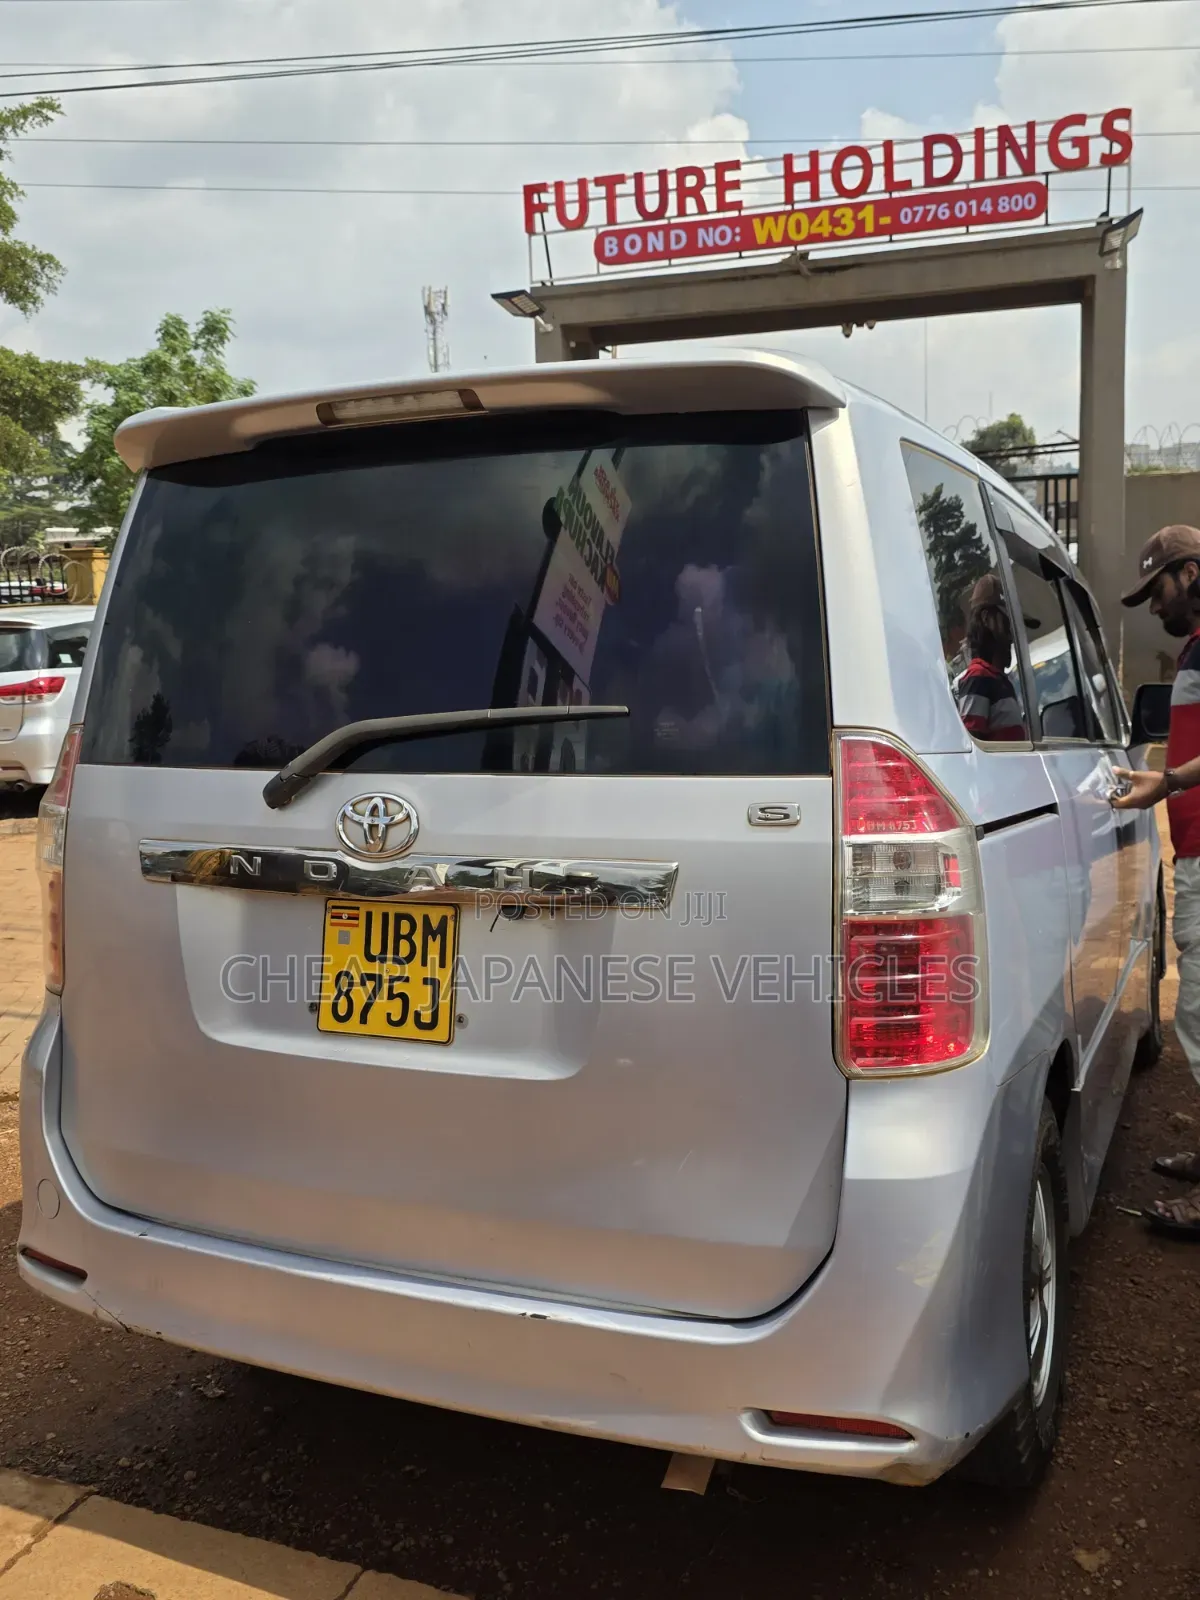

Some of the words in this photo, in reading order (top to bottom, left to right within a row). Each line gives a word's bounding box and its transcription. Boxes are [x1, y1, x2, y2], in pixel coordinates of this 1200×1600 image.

[524, 159, 742, 235] FUTURE
[783, 108, 1134, 204] HOLDINGS
[603, 228, 688, 259] BOND
[697, 223, 742, 250] NO:
[752, 204, 892, 246] W0431-
[900, 201, 951, 225] 0776
[954, 196, 994, 219] 014
[997, 191, 1037, 214] 800
[758, 806, 791, 822] S
[229, 856, 534, 890] NOAH
[363, 910, 449, 969] UBM
[330, 970, 442, 1031] 875J
